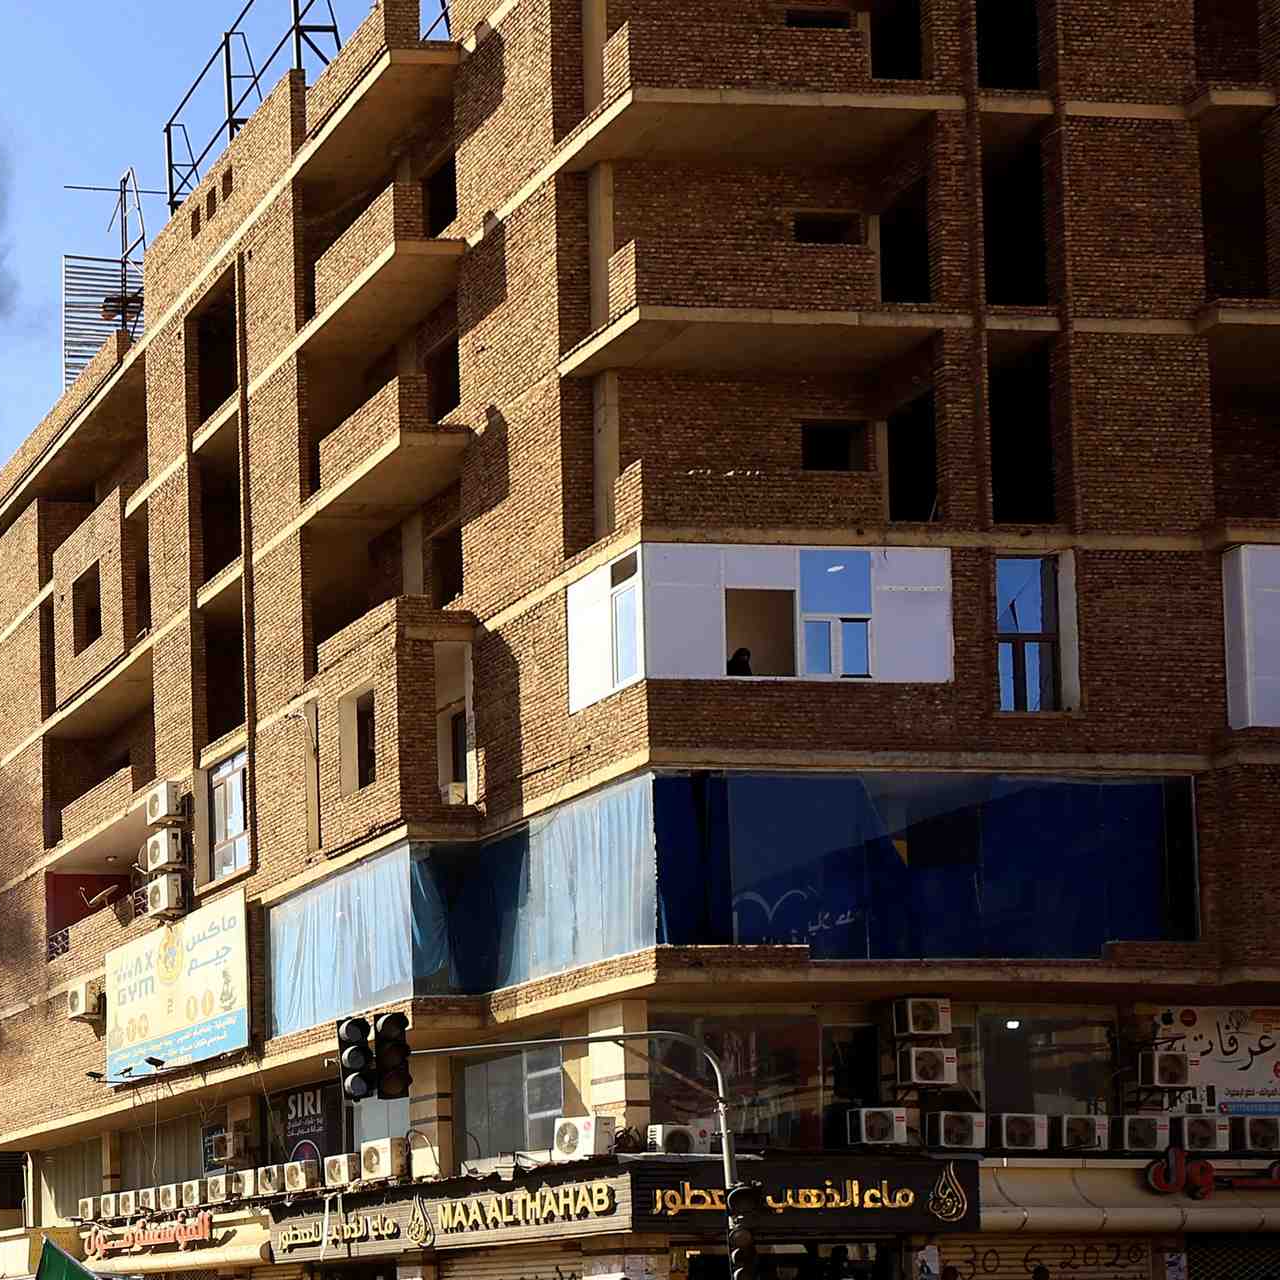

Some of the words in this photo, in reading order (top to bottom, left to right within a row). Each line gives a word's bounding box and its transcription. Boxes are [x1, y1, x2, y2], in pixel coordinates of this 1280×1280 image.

[185, 915, 237, 952] ماكس
[188, 945, 233, 976] جيم
[117, 975, 155, 1006] GYM
[1200, 1022, 1276, 1071] عرفات
[288, 1089, 322, 1120] SIRI
[766, 1179, 860, 1213] الذهب
[863, 1180, 914, 1209] ماء
[439, 1199, 483, 1230] MAA
